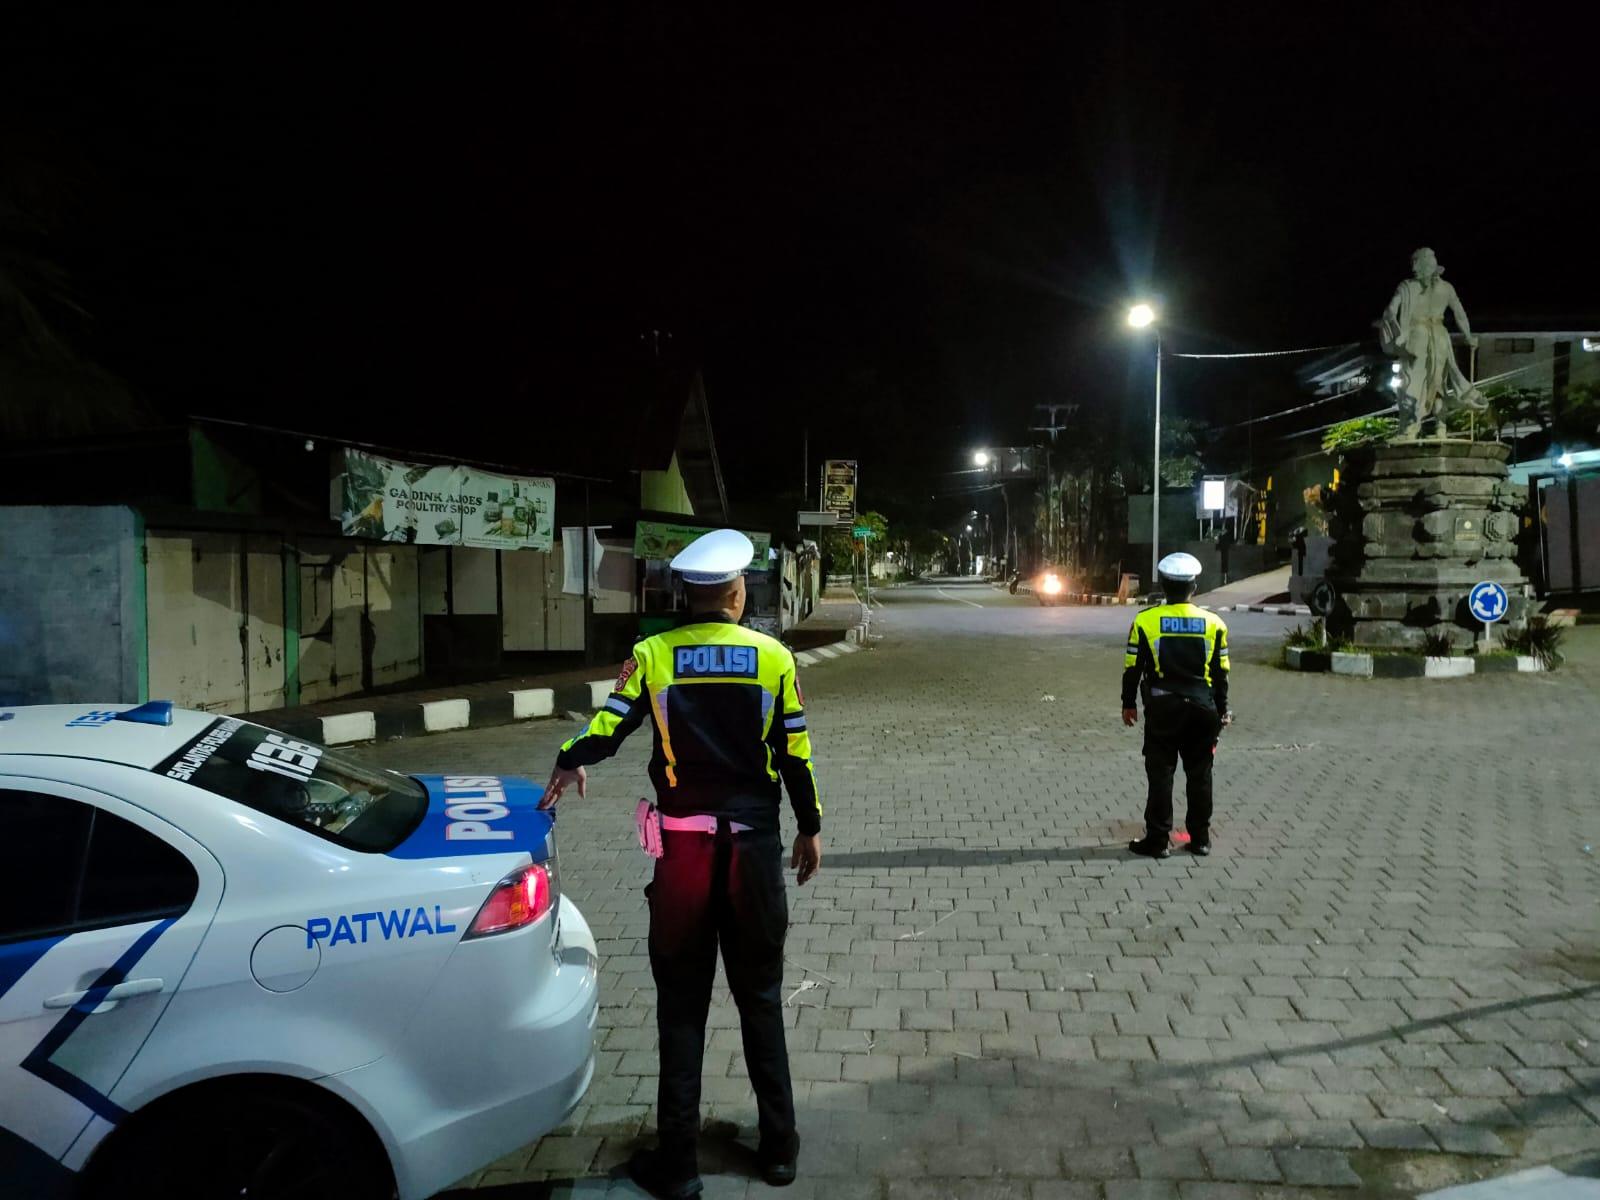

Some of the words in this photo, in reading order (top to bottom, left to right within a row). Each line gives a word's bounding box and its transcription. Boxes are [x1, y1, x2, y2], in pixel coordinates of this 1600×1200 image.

[396, 500, 448, 513] POULTRY
[450, 504, 477, 516] SHOP
[1162, 617, 1205, 632] POLISI
[677, 646, 756, 673] POLISI
[246, 733, 323, 783] 1136
[443, 776, 515, 841] POLISI
[307, 905, 457, 949] PATWAL
